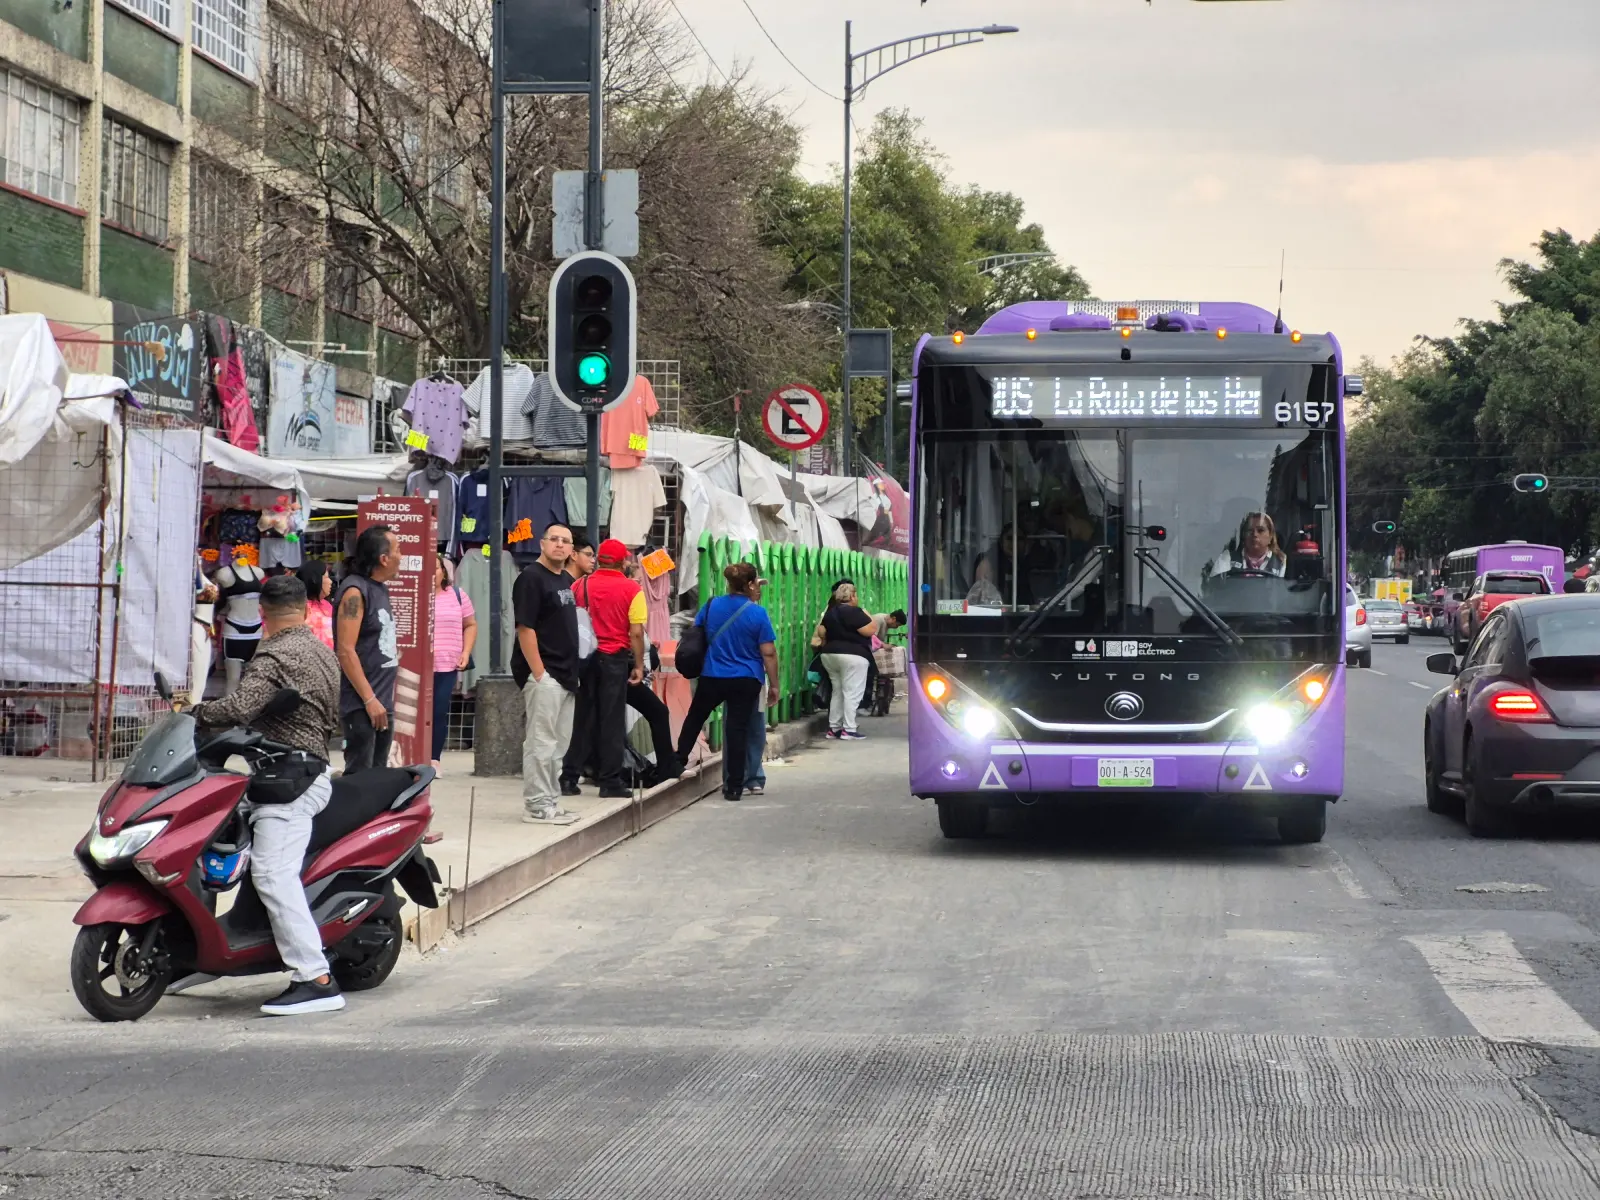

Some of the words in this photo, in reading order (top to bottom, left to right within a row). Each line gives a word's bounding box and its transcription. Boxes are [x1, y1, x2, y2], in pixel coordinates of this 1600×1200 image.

[1054, 377, 1083, 415] La
[1089, 377, 1144, 415] Ruta
[1150, 377, 1179, 415] de
[1185, 377, 1218, 415] las
[335, 397, 364, 426] ETERIA
[1275, 402, 1334, 422] 6157
[811, 443, 823, 475] antito
[378, 503, 396, 511] RED
[398, 504, 411, 512] DE
[366, 512, 424, 522] TRANSPORTE
[1051, 673, 1200, 681] YUTONG
[1100, 766, 1152, 778] 001-A-524
